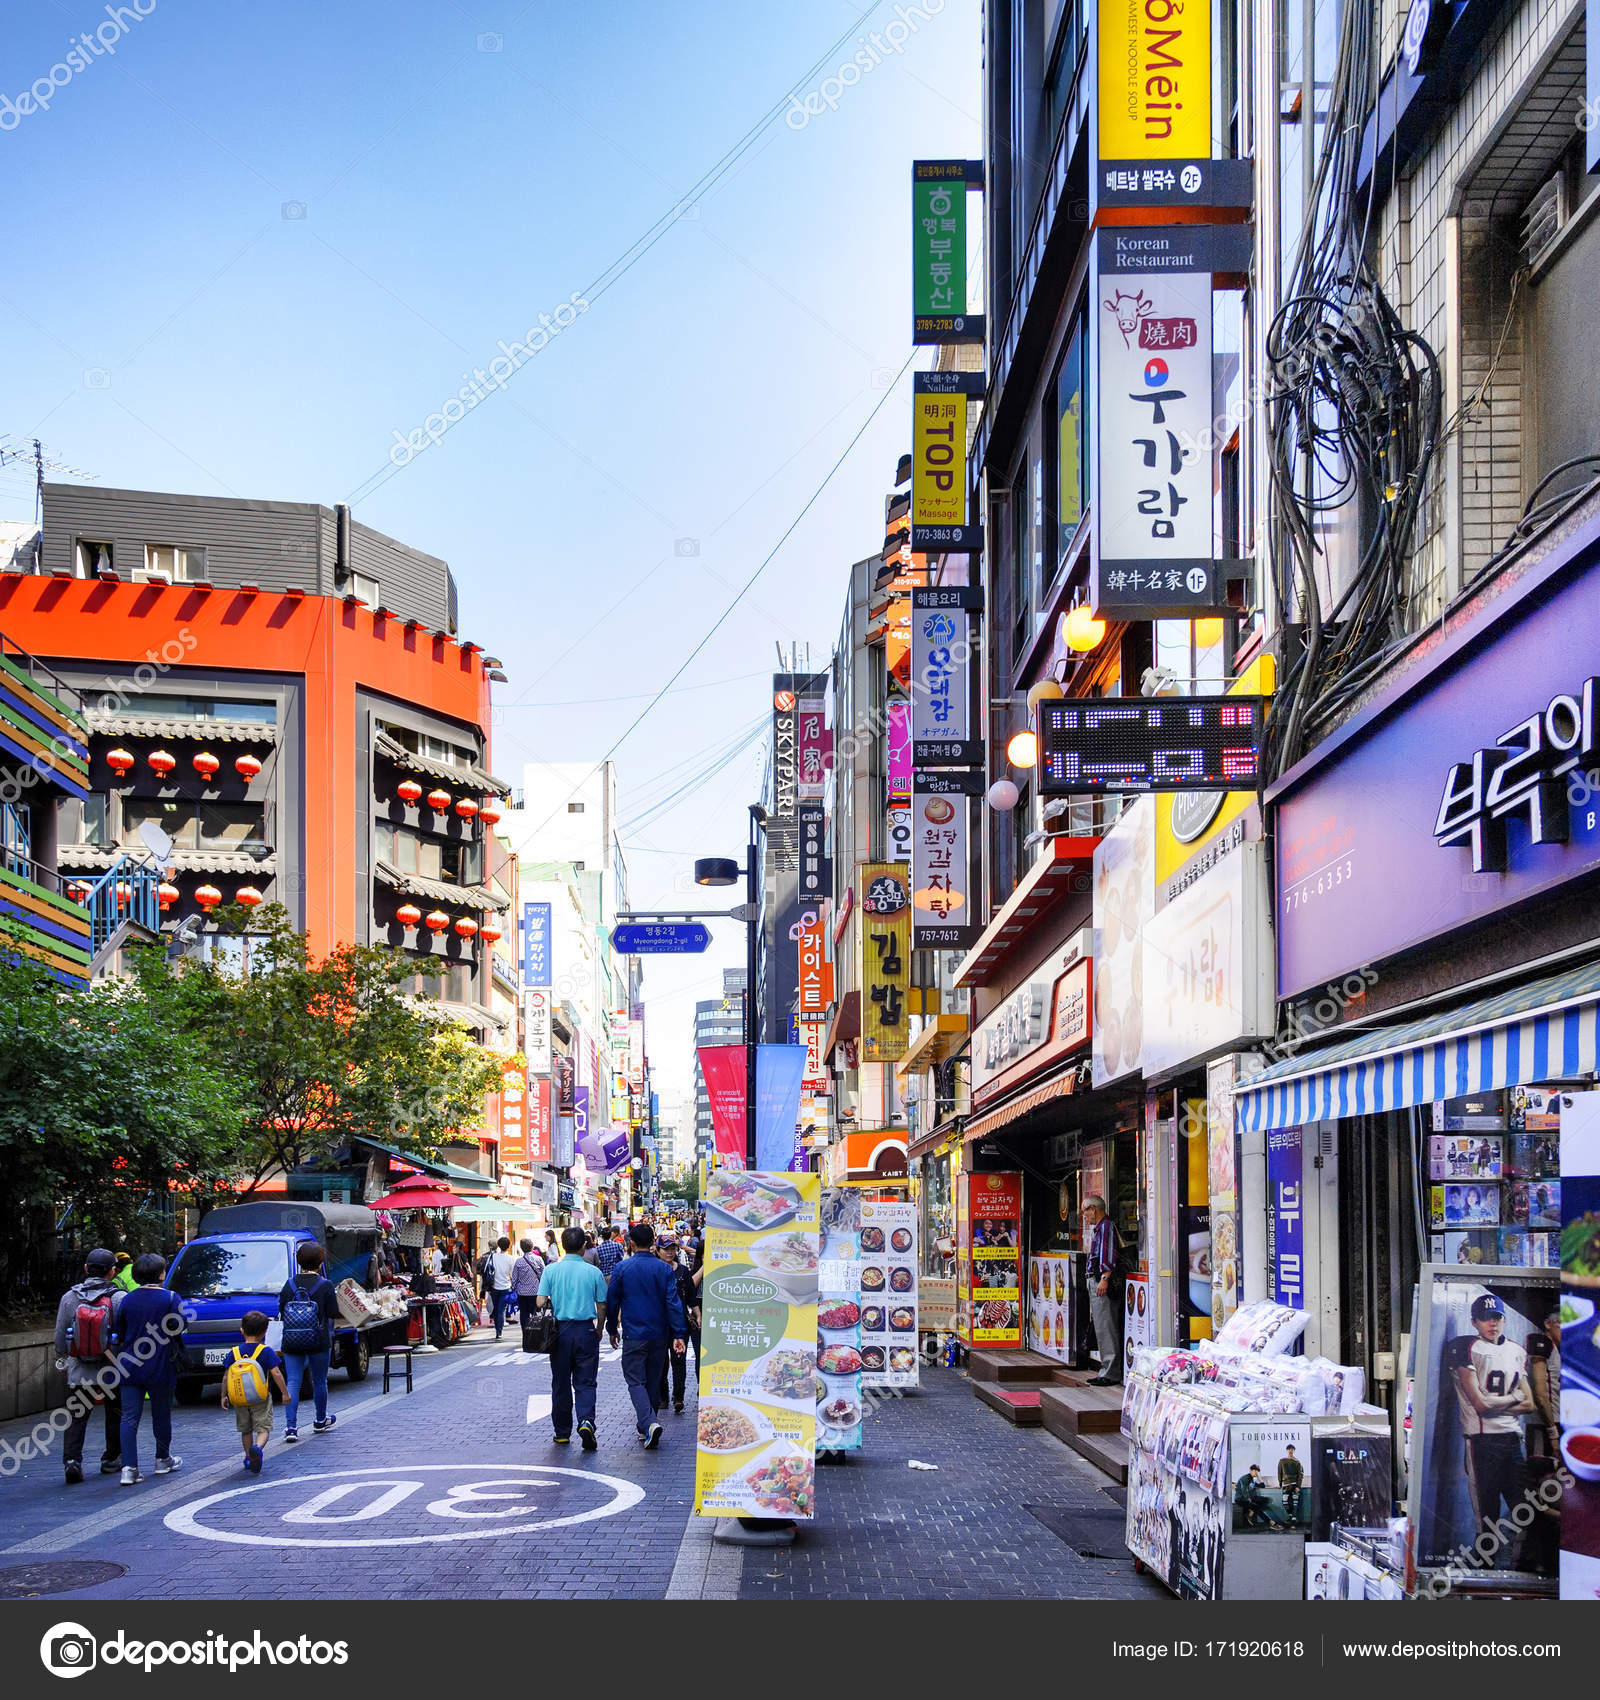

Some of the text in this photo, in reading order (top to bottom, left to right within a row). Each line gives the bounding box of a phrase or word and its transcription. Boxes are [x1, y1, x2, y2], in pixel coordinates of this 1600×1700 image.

[1127, 39, 1138, 81] NOODLE
[1127, 84, 1138, 121] SOUP
[1106, 170, 1199, 191] 베트남 쌀국수 2F
[922, 218, 957, 235] 행복
[1116, 236, 1169, 250] Korean
[1116, 253, 1194, 267] Restaurant
[929, 239, 954, 309] 부동산
[916, 319, 953, 331] 3789-2783
[1143, 321, 1191, 347] 燒肉
[927, 384, 956, 393] Nailart
[924, 404, 957, 418] 明洞
[926, 421, 954, 491] TOP
[1128, 357, 1190, 539] 우가람
[919, 497, 958, 506] マッサージ
[919, 509, 958, 520] Massage
[916, 529, 951, 540] 773-3863
[1106, 569, 1206, 593] 韓牛名家 1F
[917, 593, 960, 606] 해물요리
[922, 727, 960, 737] オデガム
[803, 716, 821, 772] 名家
[802, 812, 823, 822] cafe
[923, 829, 957, 845] 원당
[806, 823, 819, 889] SOHO
[928, 849, 952, 919] 감자탕
[1285, 861, 1352, 914] 776-6353
[646, 926, 676, 937] 명동2길
[920, 931, 959, 941] 757-7612
[634, 937, 672, 945] Myeongdong
[803, 934, 821, 1007] 카이스트
[870, 931, 904, 1026] 김밥
[807, 1023, 819, 1073] 디디치킨
[530, 1083, 540, 1157] BEAUTY SHOP
[575, 1098, 587, 1142] VDL
[610, 1143, 628, 1158] VDL
[1269, 1135, 1302, 1151] 부루의뜨락
[1279, 1181, 1300, 1307] 부루
[719, 1320, 767, 1334] 쌀국수는
[725, 1335, 760, 1348] 포메인
[1241, 1432, 1302, 1441] TOHOSHINKI
[1337, 1450, 1368, 1460] B.A.P
[281, 1480, 560, 1524] 30
